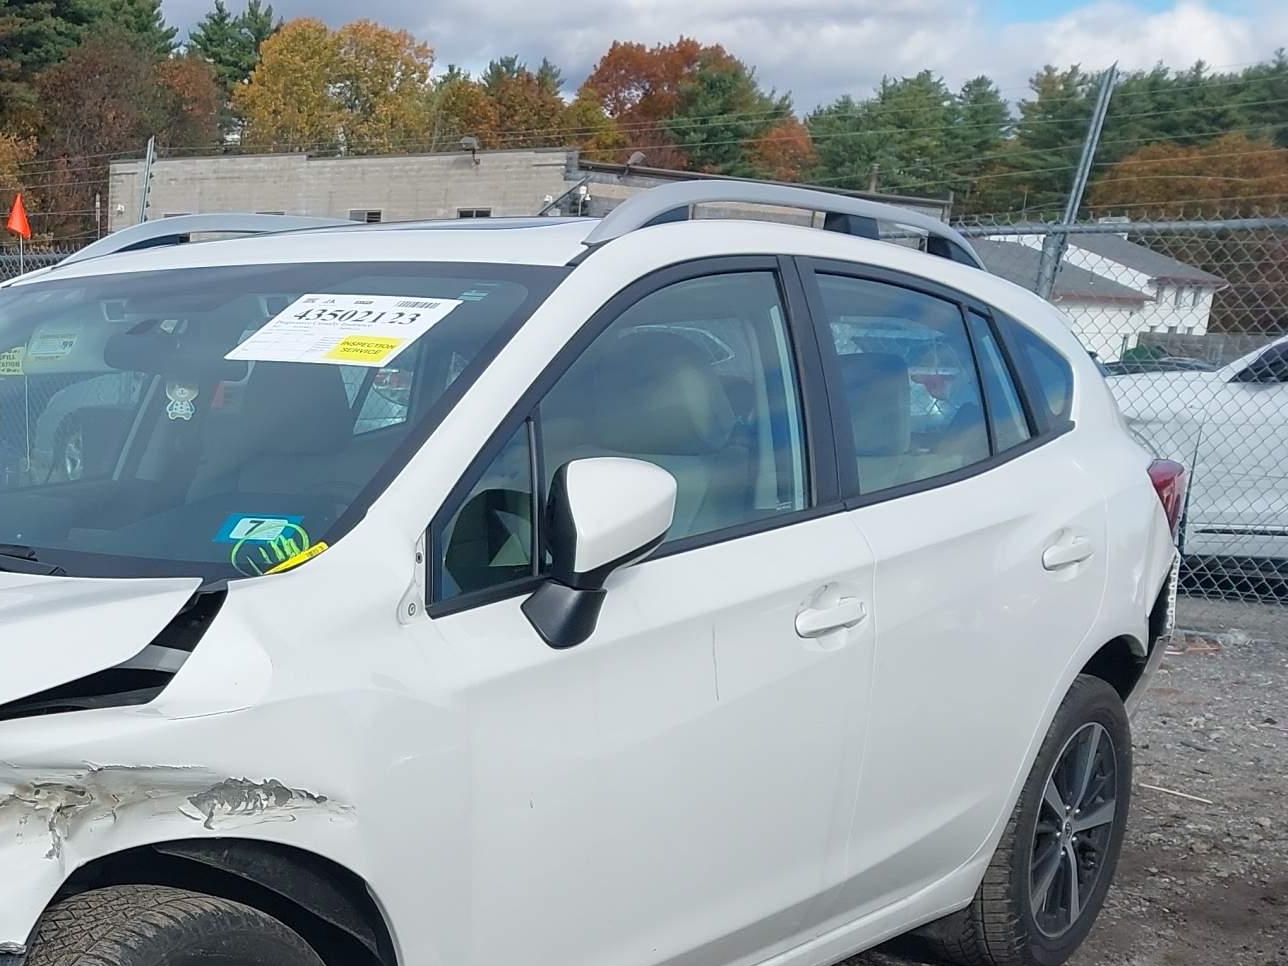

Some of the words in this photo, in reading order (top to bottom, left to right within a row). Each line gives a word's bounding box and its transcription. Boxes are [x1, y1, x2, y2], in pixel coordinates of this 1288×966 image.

[294, 308, 421, 325] 43502123
[340, 341, 396, 350] INSPECTION
[340, 347, 381, 355] SERVICE
[244, 521, 265, 535] 7
